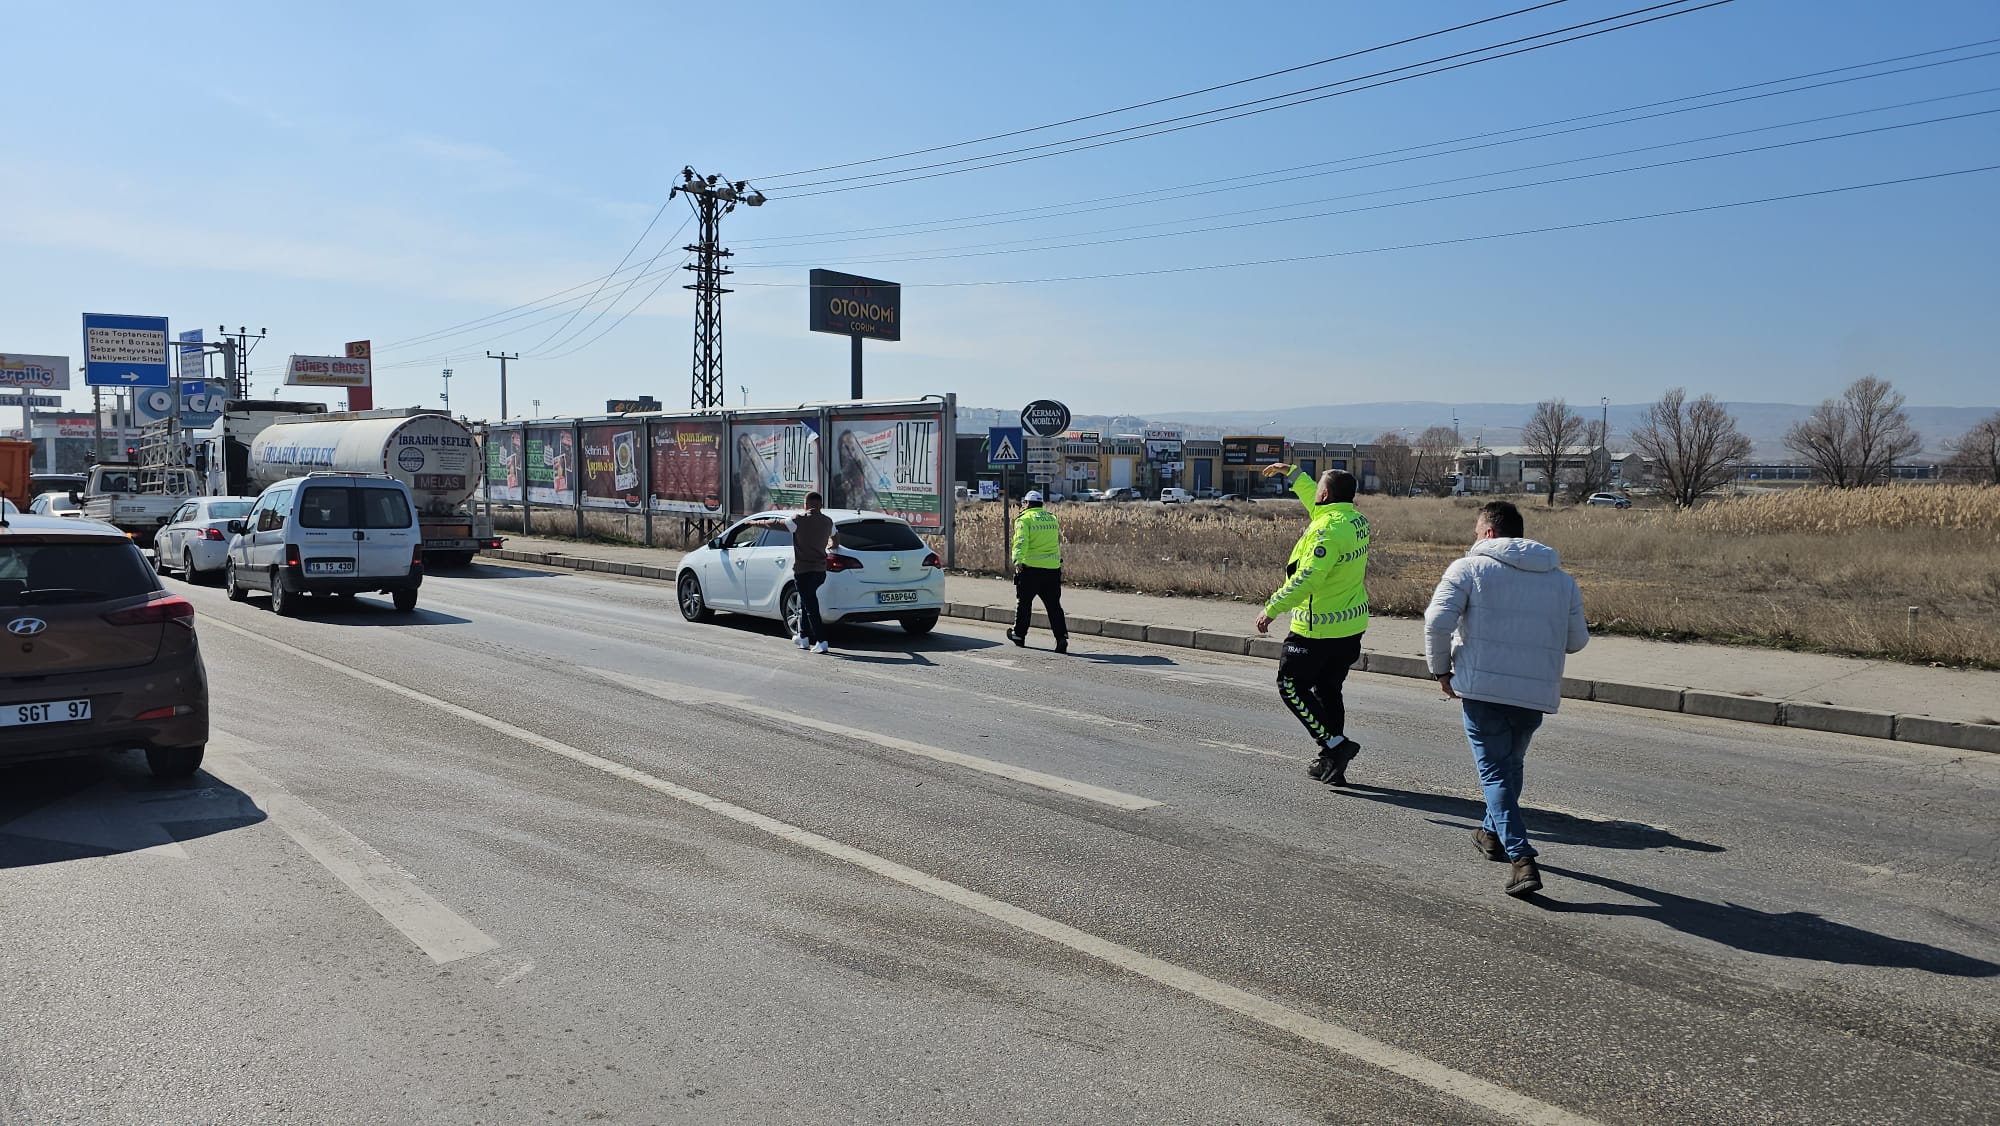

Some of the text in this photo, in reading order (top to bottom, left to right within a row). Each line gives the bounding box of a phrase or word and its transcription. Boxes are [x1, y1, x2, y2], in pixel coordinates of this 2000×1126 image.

[90, 337, 124, 345] Ticaret
[119, 347, 146, 355] Meyve
[91, 354, 141, 362] Nakliyeciler
[294, 360, 366, 375] GÜNEŞ GROSS
[27, 396, 54, 406] GIDA
[1031, 409, 1062, 417] KERMAN
[1031, 417, 1061, 426] MOBİLYA
[399, 433, 439, 446] İBRAHİM
[896, 421, 934, 484] GAZZE
[420, 476, 460, 488] MELAS
[338, 562, 352, 570] 430
[18, 701, 89, 723] SGT 97
